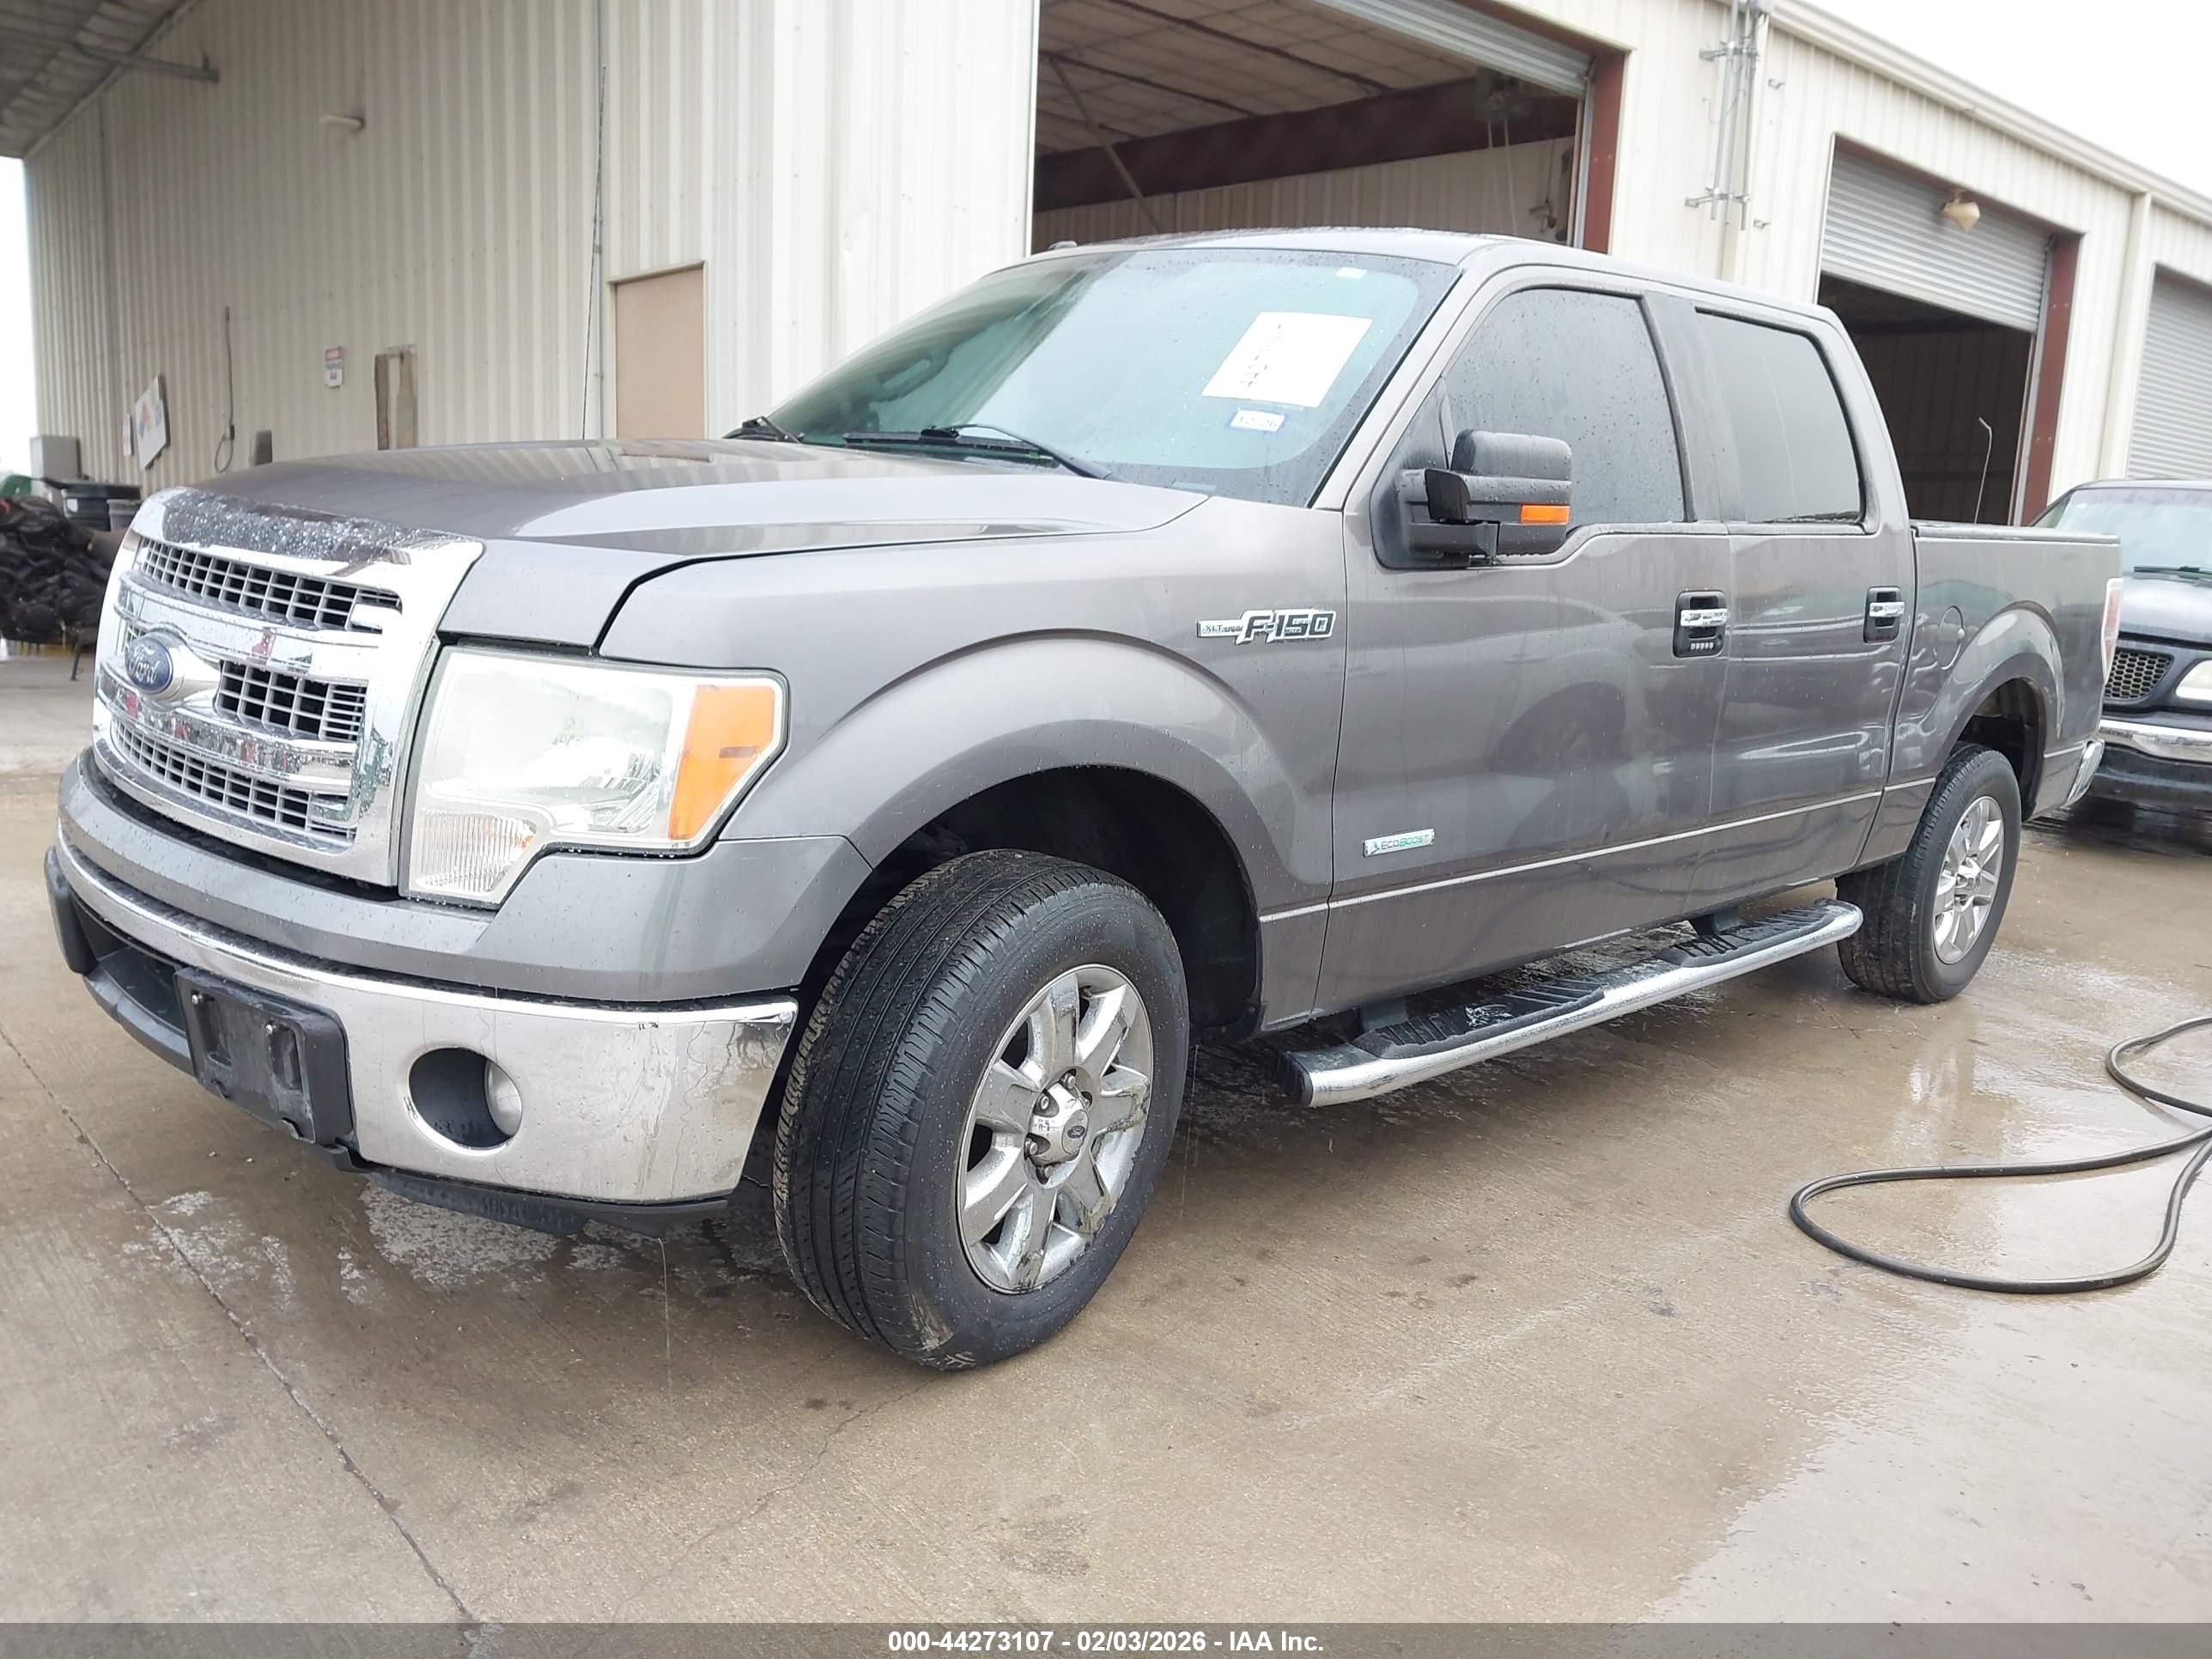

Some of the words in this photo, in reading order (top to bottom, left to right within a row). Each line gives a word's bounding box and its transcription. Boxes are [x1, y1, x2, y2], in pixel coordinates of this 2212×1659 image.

[1245, 612, 1335, 640] F-150
[128, 644, 161, 685] Ford
[1381, 834, 1430, 850] ECOBOOST
